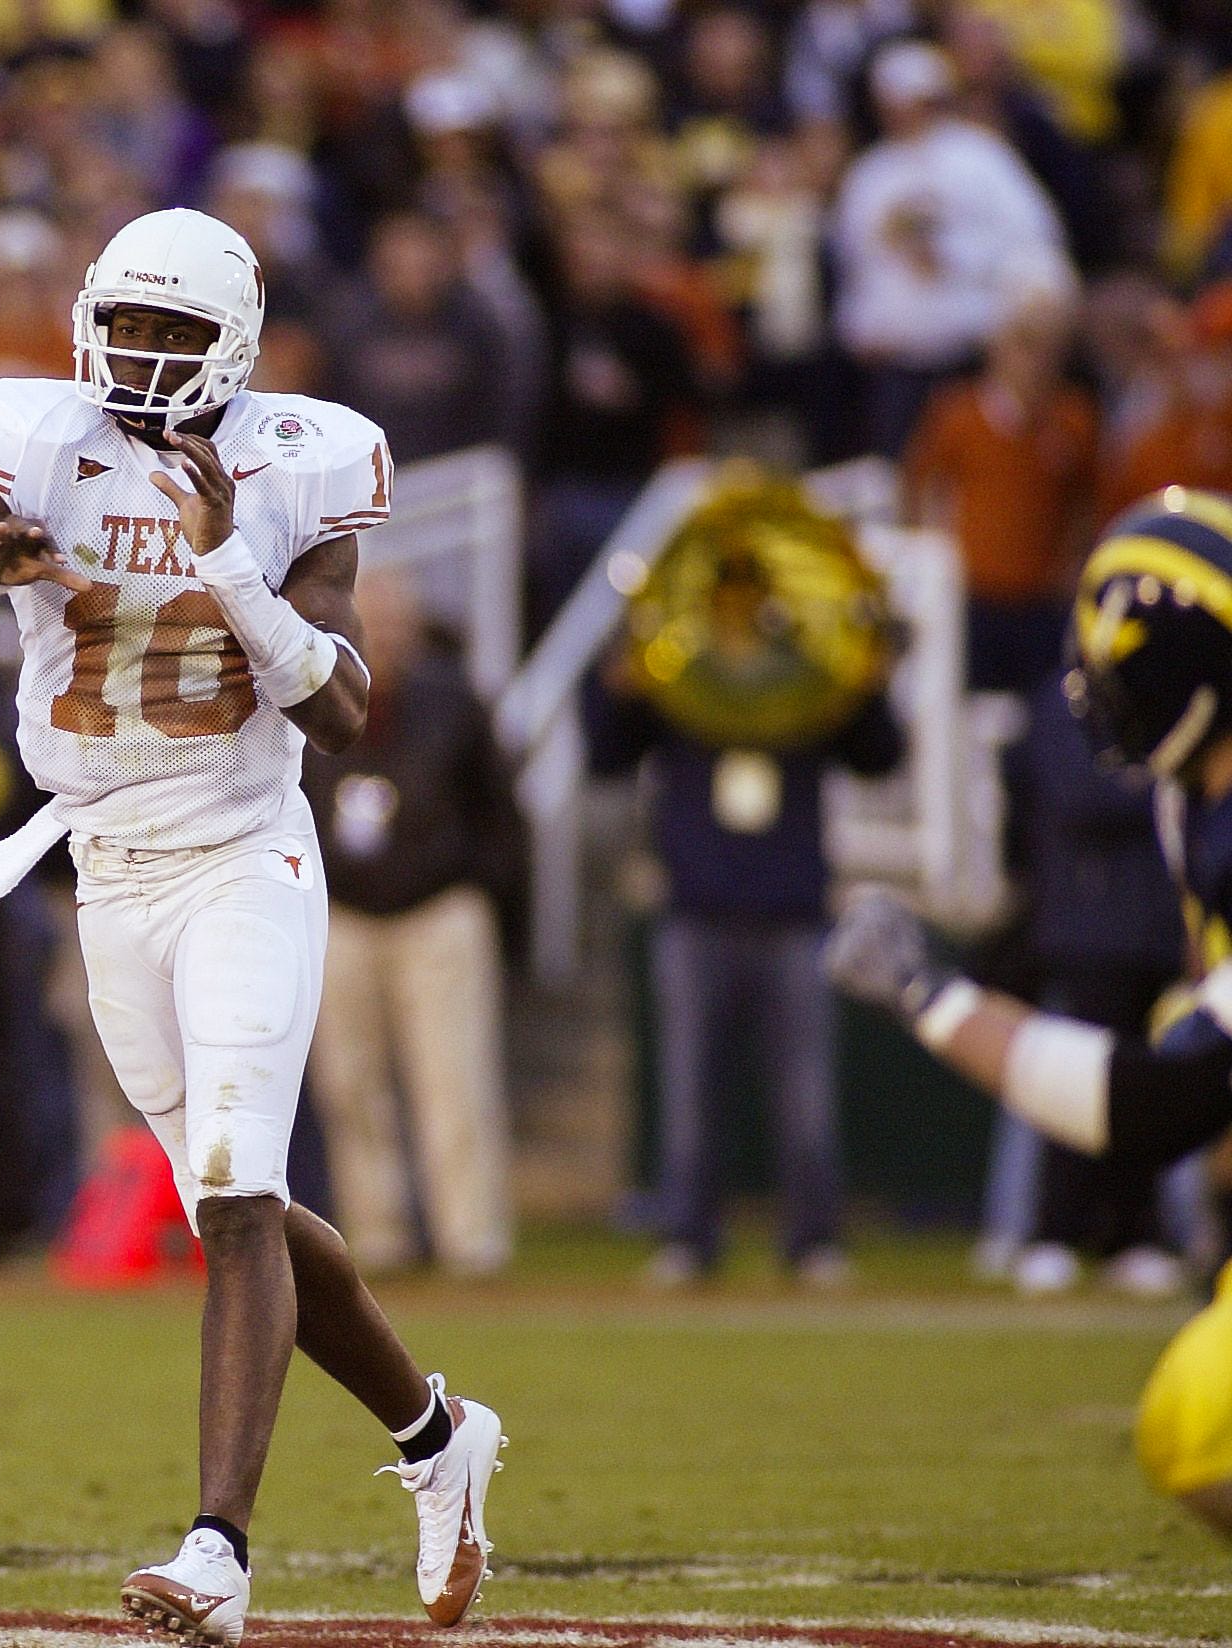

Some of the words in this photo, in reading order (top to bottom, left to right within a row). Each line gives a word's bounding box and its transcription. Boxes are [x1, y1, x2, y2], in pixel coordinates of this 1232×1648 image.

[257, 416, 273, 435] ROSE
[273, 411, 303, 420] BOWL
[50, 580, 258, 738] 10
